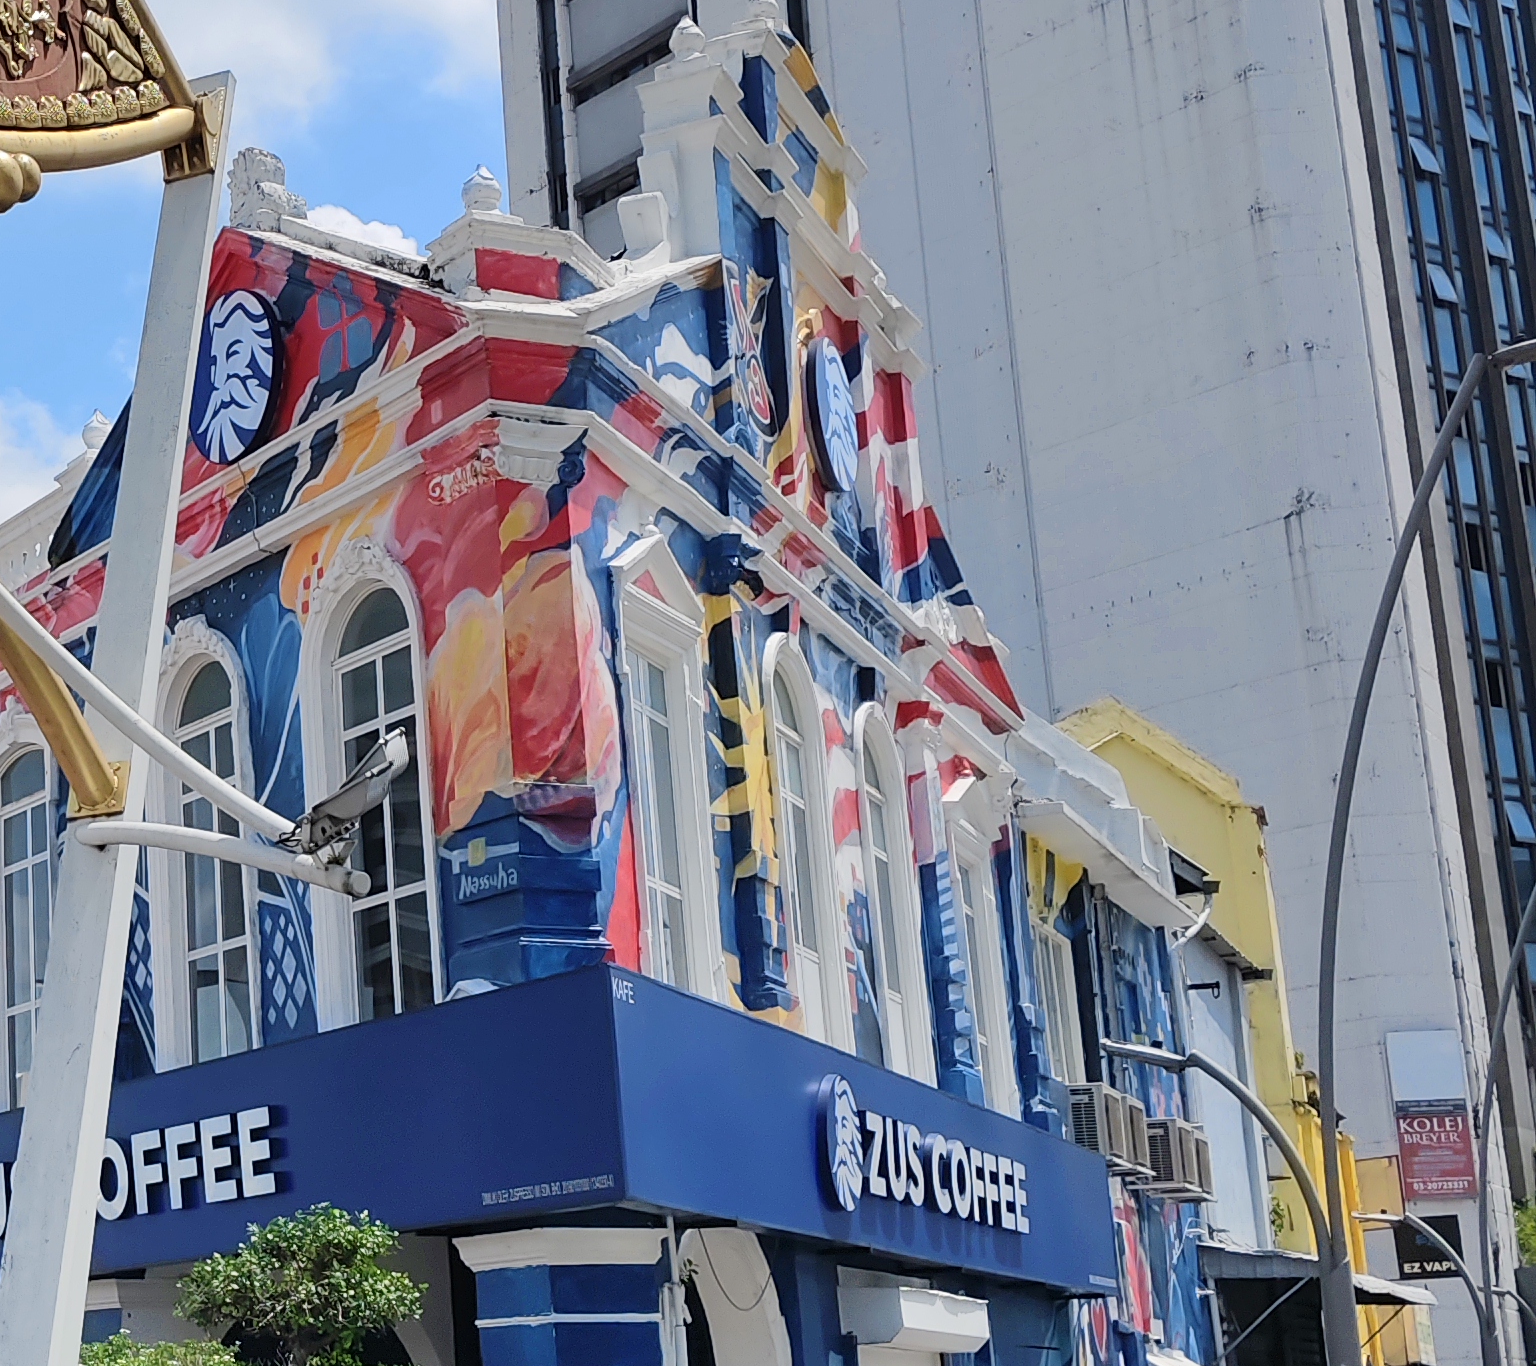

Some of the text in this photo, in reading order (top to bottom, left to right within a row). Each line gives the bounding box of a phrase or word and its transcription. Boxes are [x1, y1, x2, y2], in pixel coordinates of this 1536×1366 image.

[458, 862, 517, 900] Nassuha
[612, 976, 635, 1004] KAFE
[1399, 1116, 1464, 1134] KOLEJ
[1403, 1132, 1461, 1145] BREYER
[96, 1106, 276, 1221] OFFEE
[866, 1110, 1030, 1235] ZUS COFFEE
[1403, 1263, 1422, 1274] EZ
